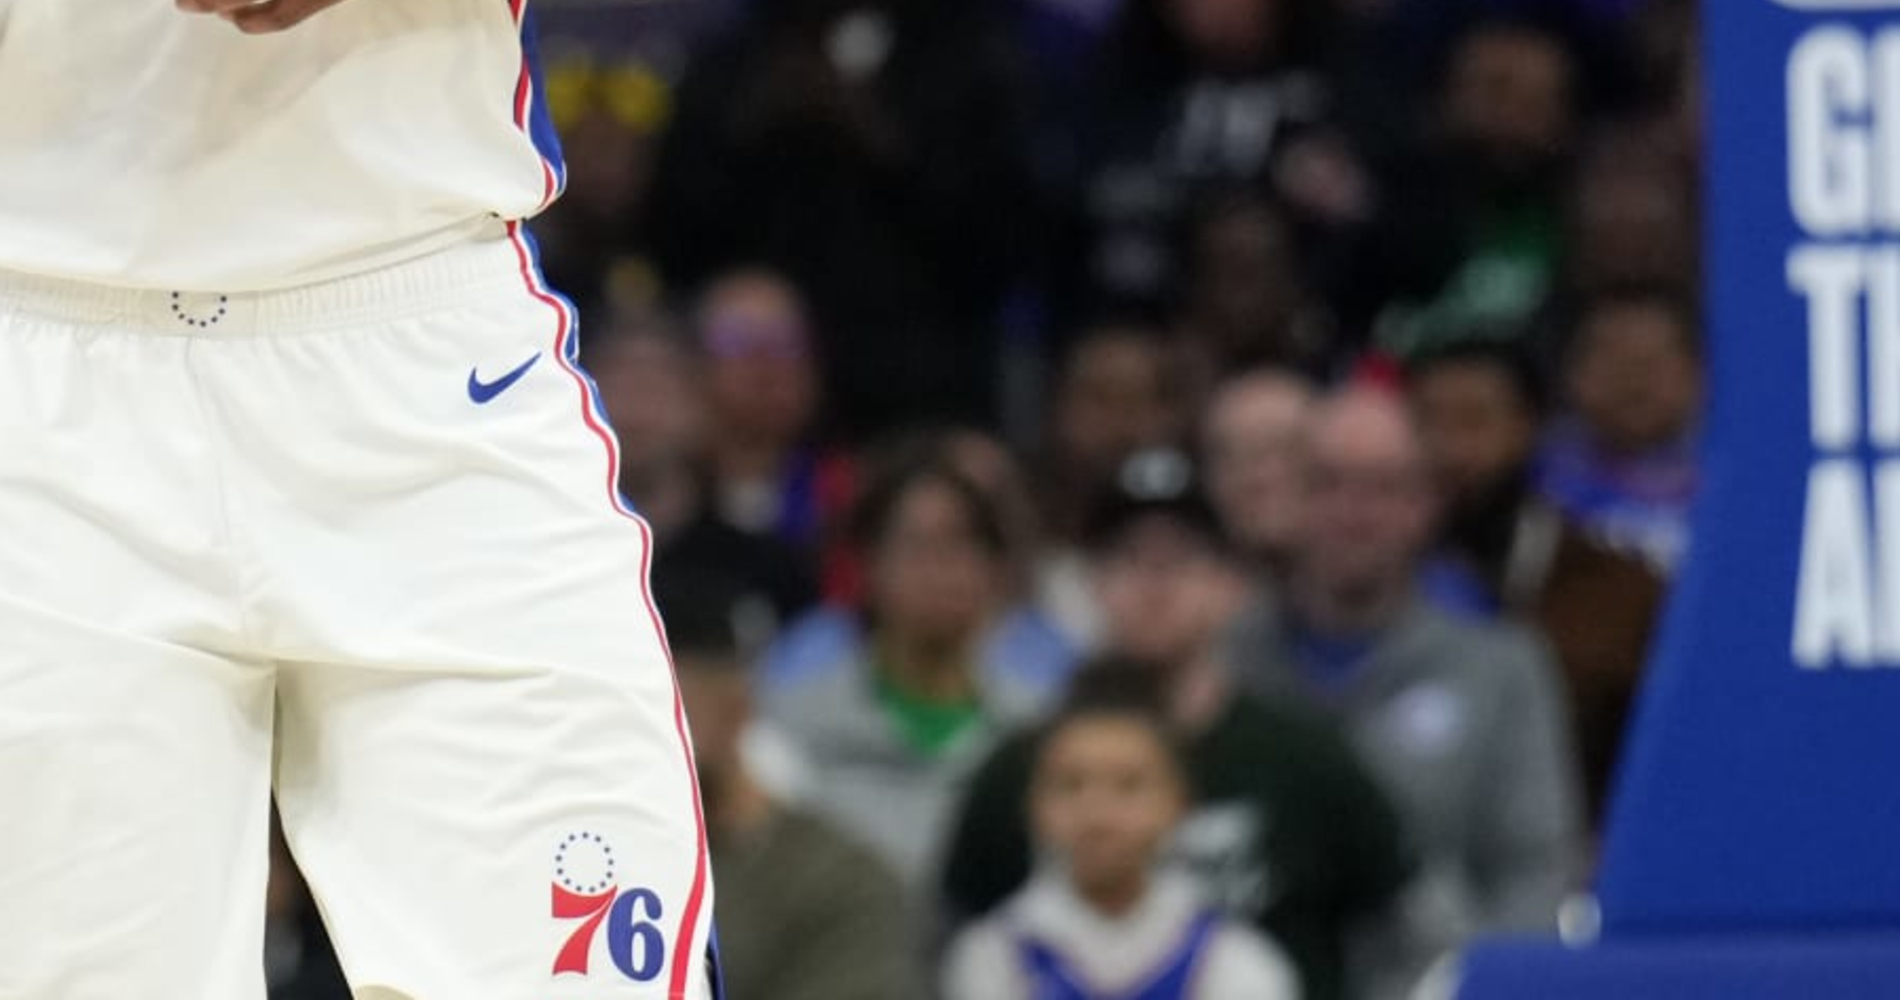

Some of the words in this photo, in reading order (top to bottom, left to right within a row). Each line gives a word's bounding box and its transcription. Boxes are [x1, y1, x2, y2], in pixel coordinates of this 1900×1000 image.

[1786, 22, 1900, 238] G
[1785, 243, 1900, 453] T
[1790, 456, 1900, 668] A
[552, 881, 665, 982] 76
